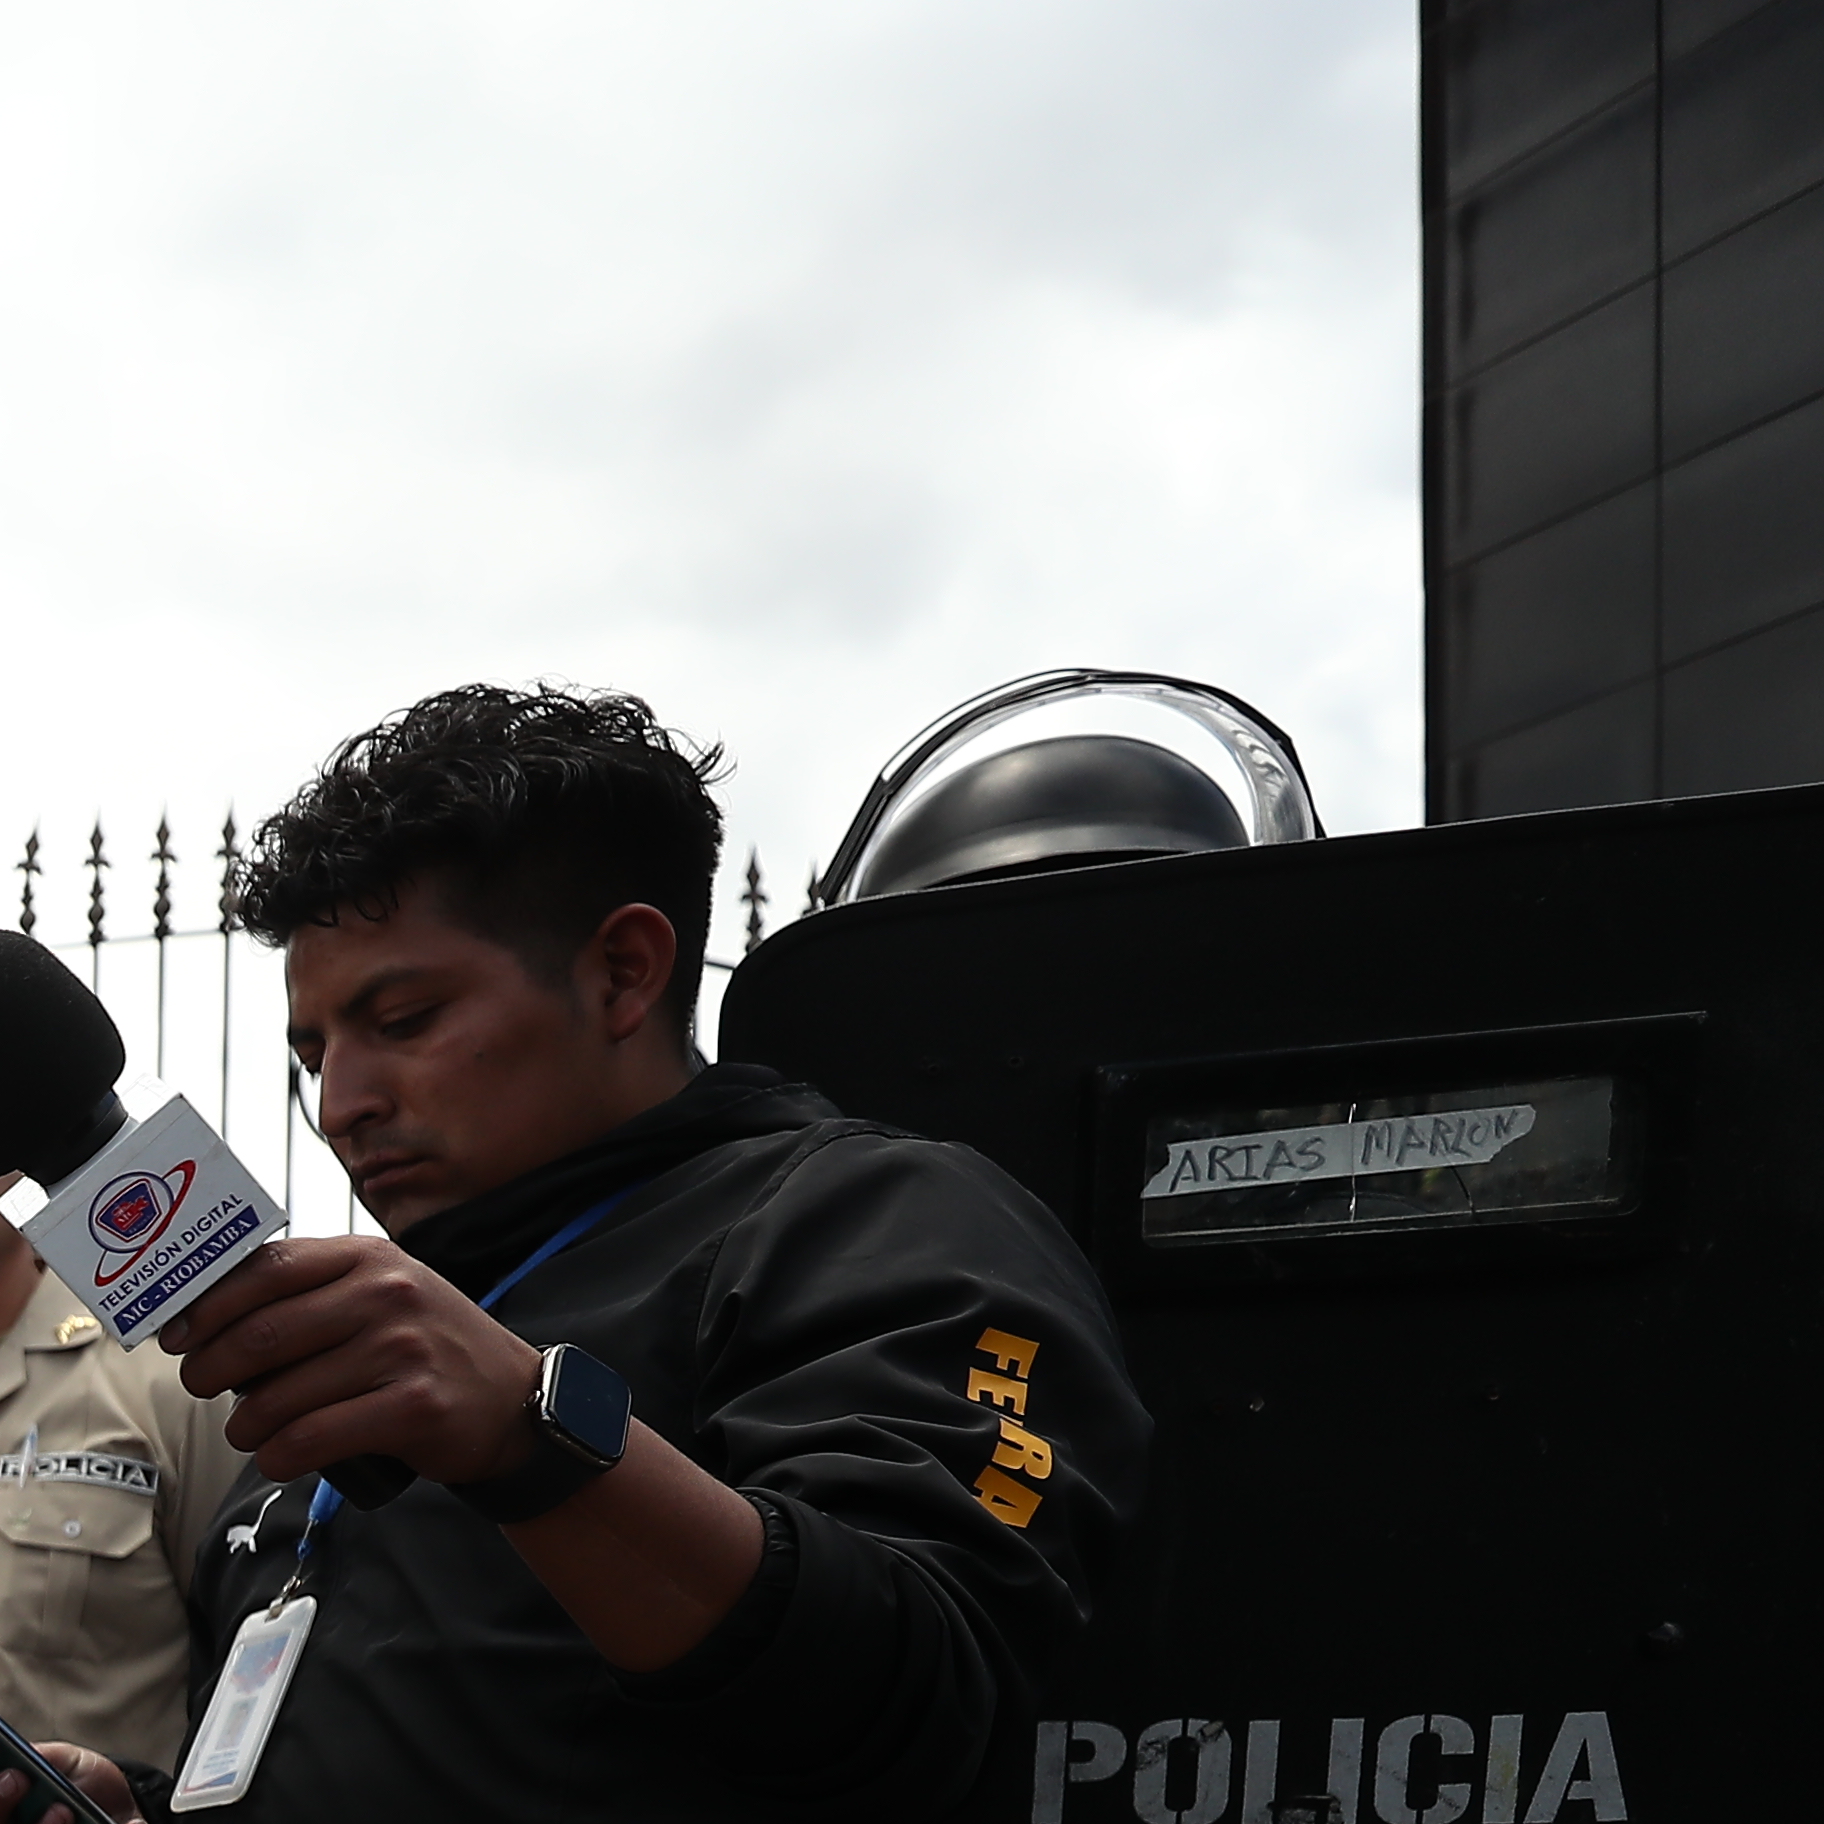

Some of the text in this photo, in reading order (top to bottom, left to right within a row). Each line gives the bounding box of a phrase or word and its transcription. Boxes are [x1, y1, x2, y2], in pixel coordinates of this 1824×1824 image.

[1169, 1107, 1519, 1193] ARIAS MARLON
[98, 1192, 244, 1313] TELEVISIÓN DIGITAL
[120, 1296, 153, 1327] MC
[160, 1218, 253, 1295] RIOBAMBA
[2, 1456, 151, 1489] POLICIA
